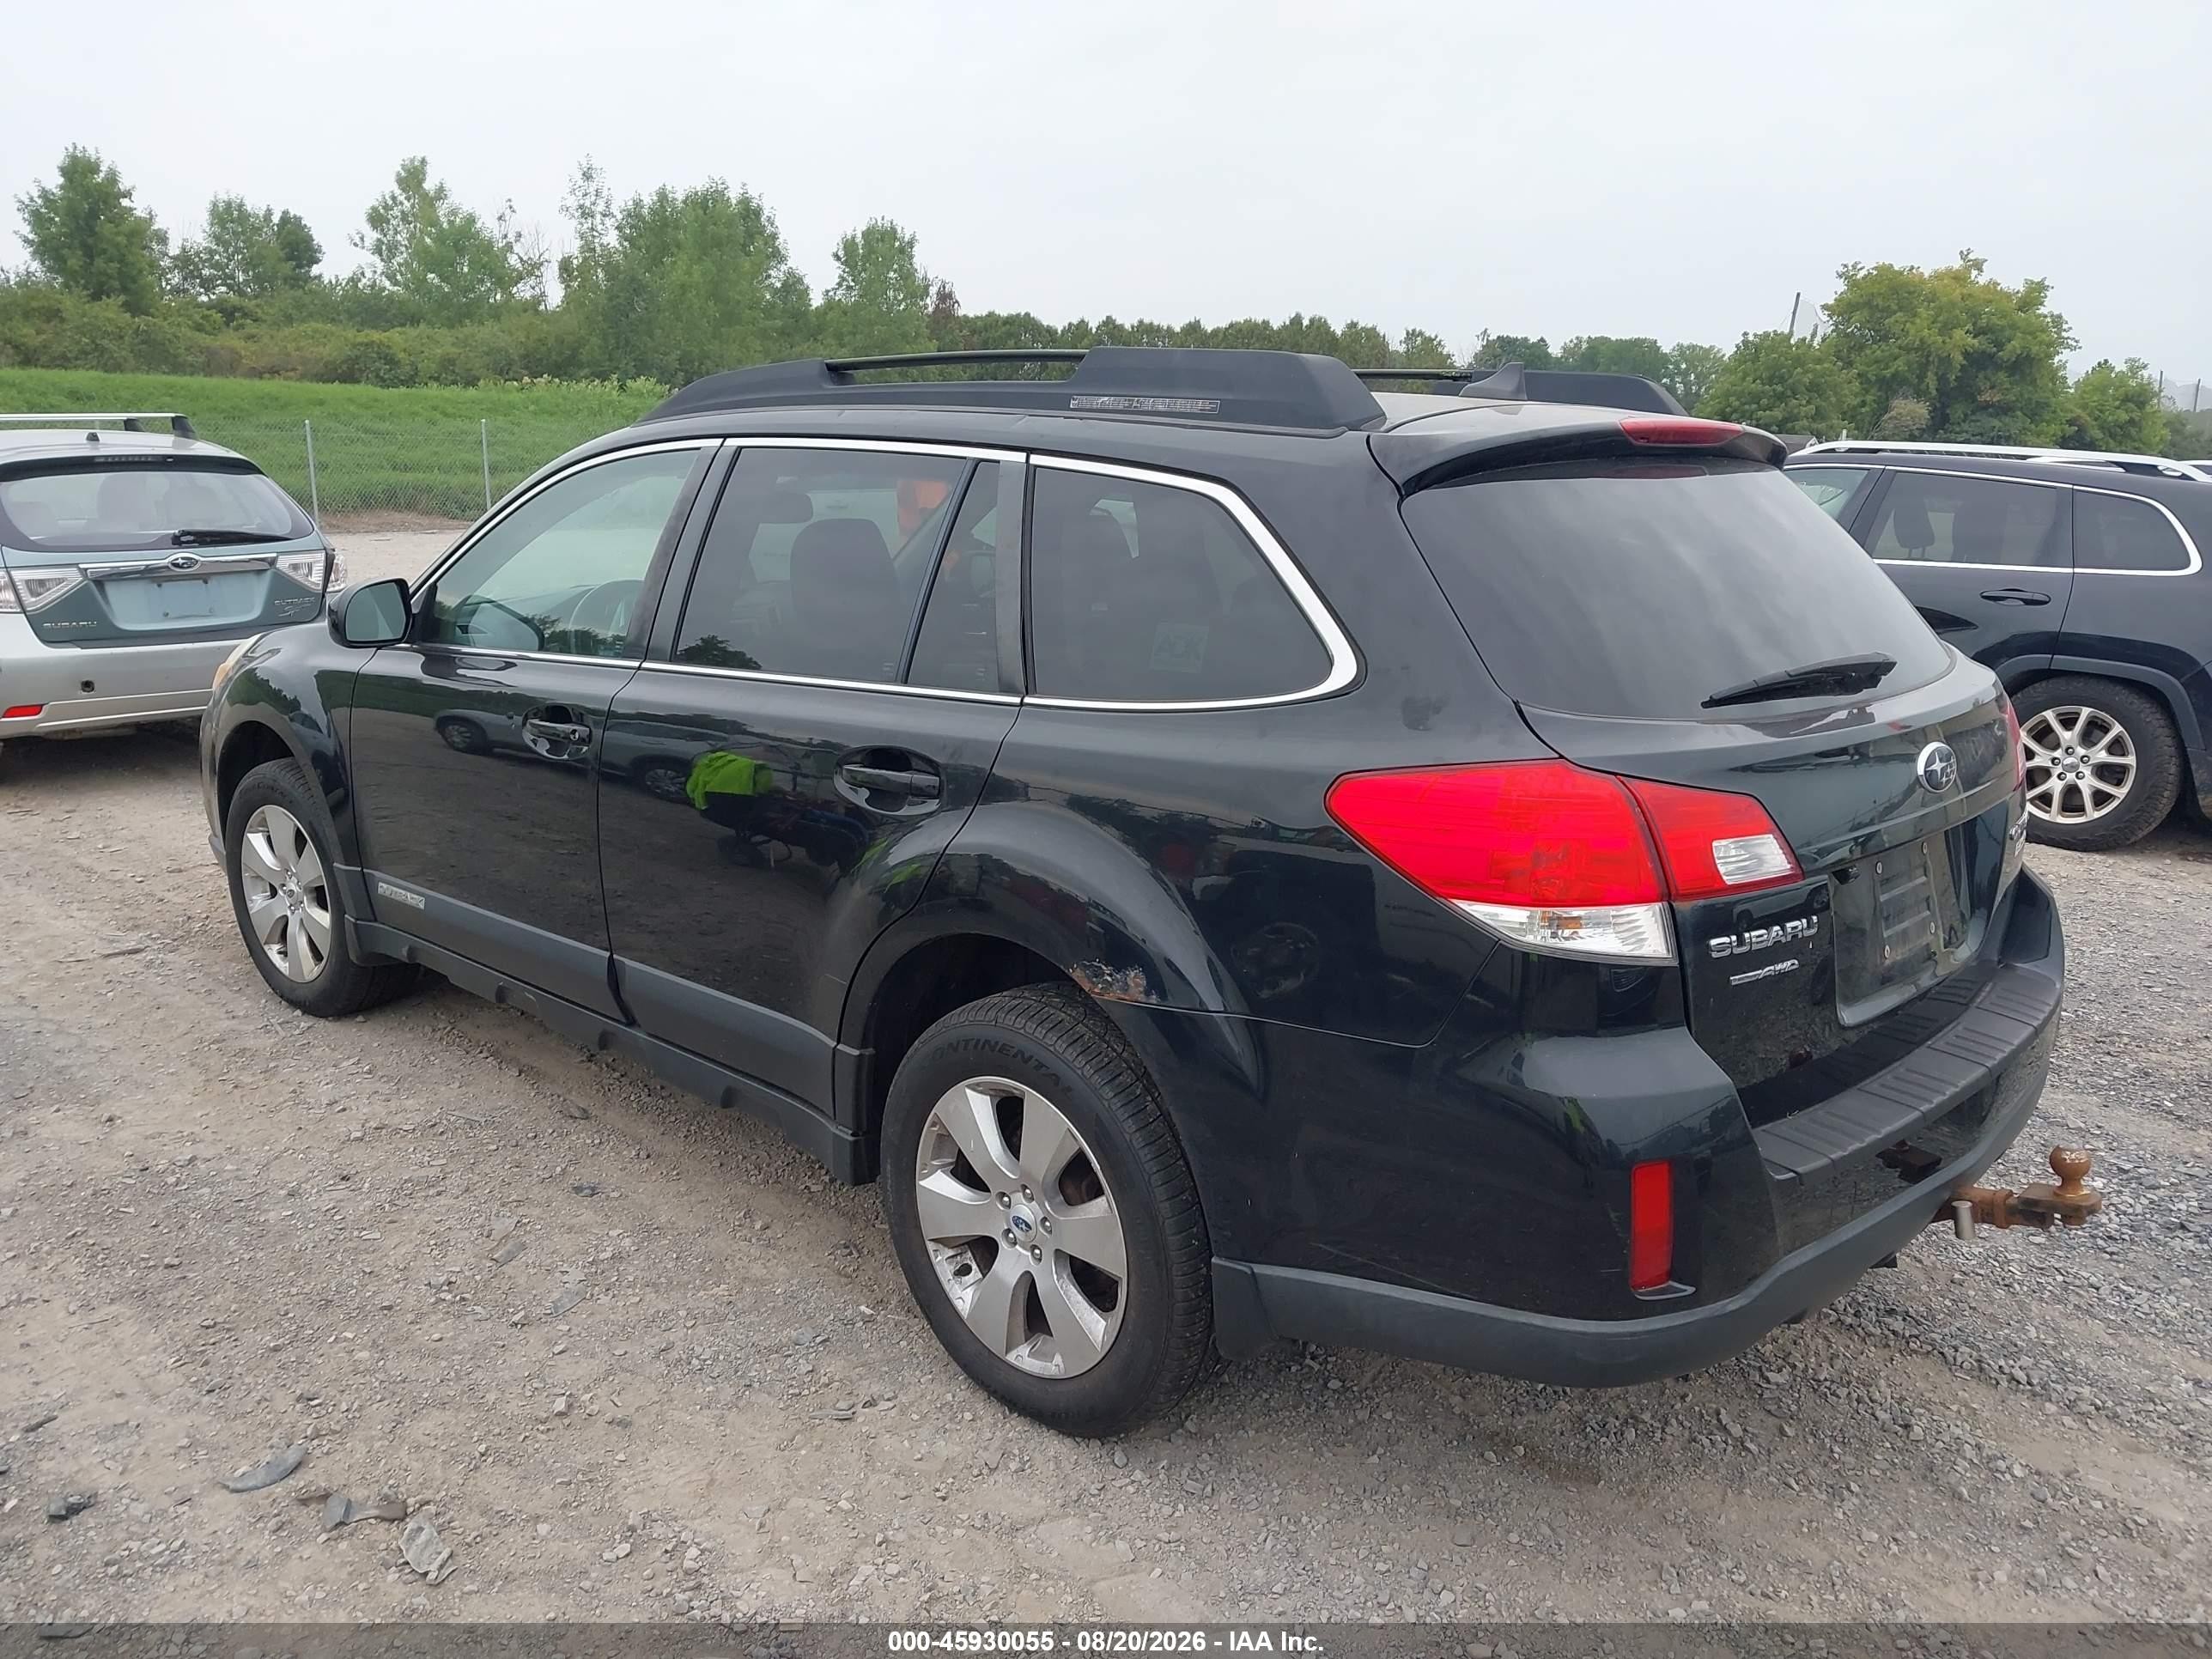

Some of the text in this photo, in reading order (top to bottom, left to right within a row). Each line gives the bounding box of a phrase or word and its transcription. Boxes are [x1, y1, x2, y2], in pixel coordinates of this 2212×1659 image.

[1709, 915, 1819, 958] SUBARU
[1758, 958, 1800, 979] AWD
[922, 1037, 1073, 1099] ONTINENTAL
